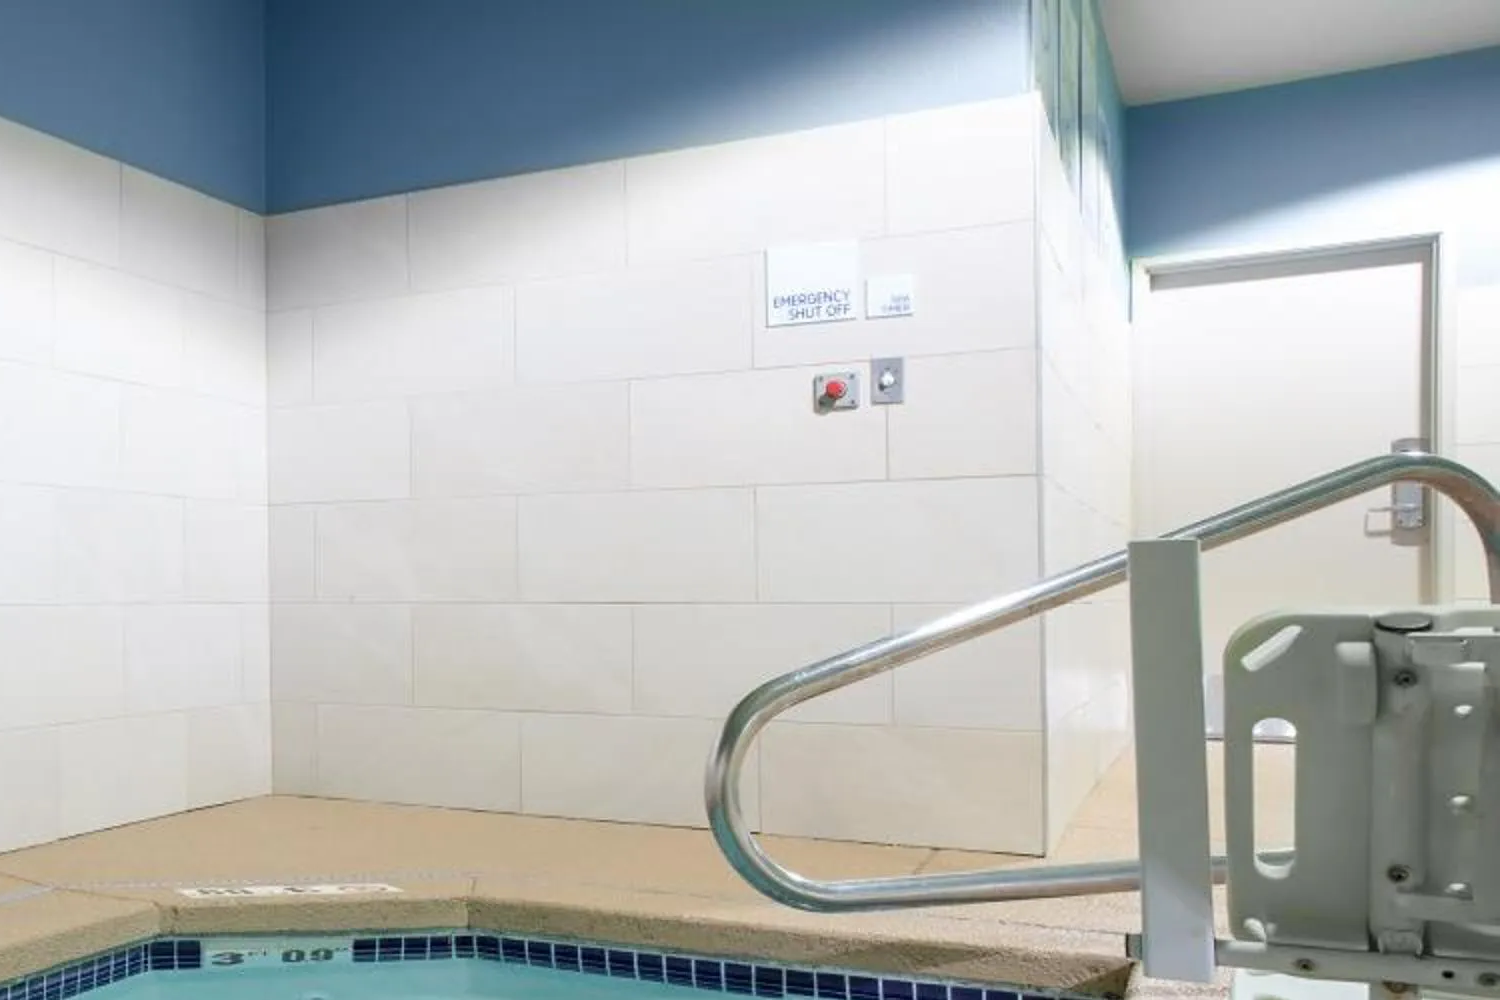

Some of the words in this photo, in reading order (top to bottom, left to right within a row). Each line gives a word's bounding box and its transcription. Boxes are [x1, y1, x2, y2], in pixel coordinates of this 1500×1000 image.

[773, 289, 851, 309] EMERGENCY
[788, 306, 822, 320] SHUT
[825, 303, 852, 317] OFF
